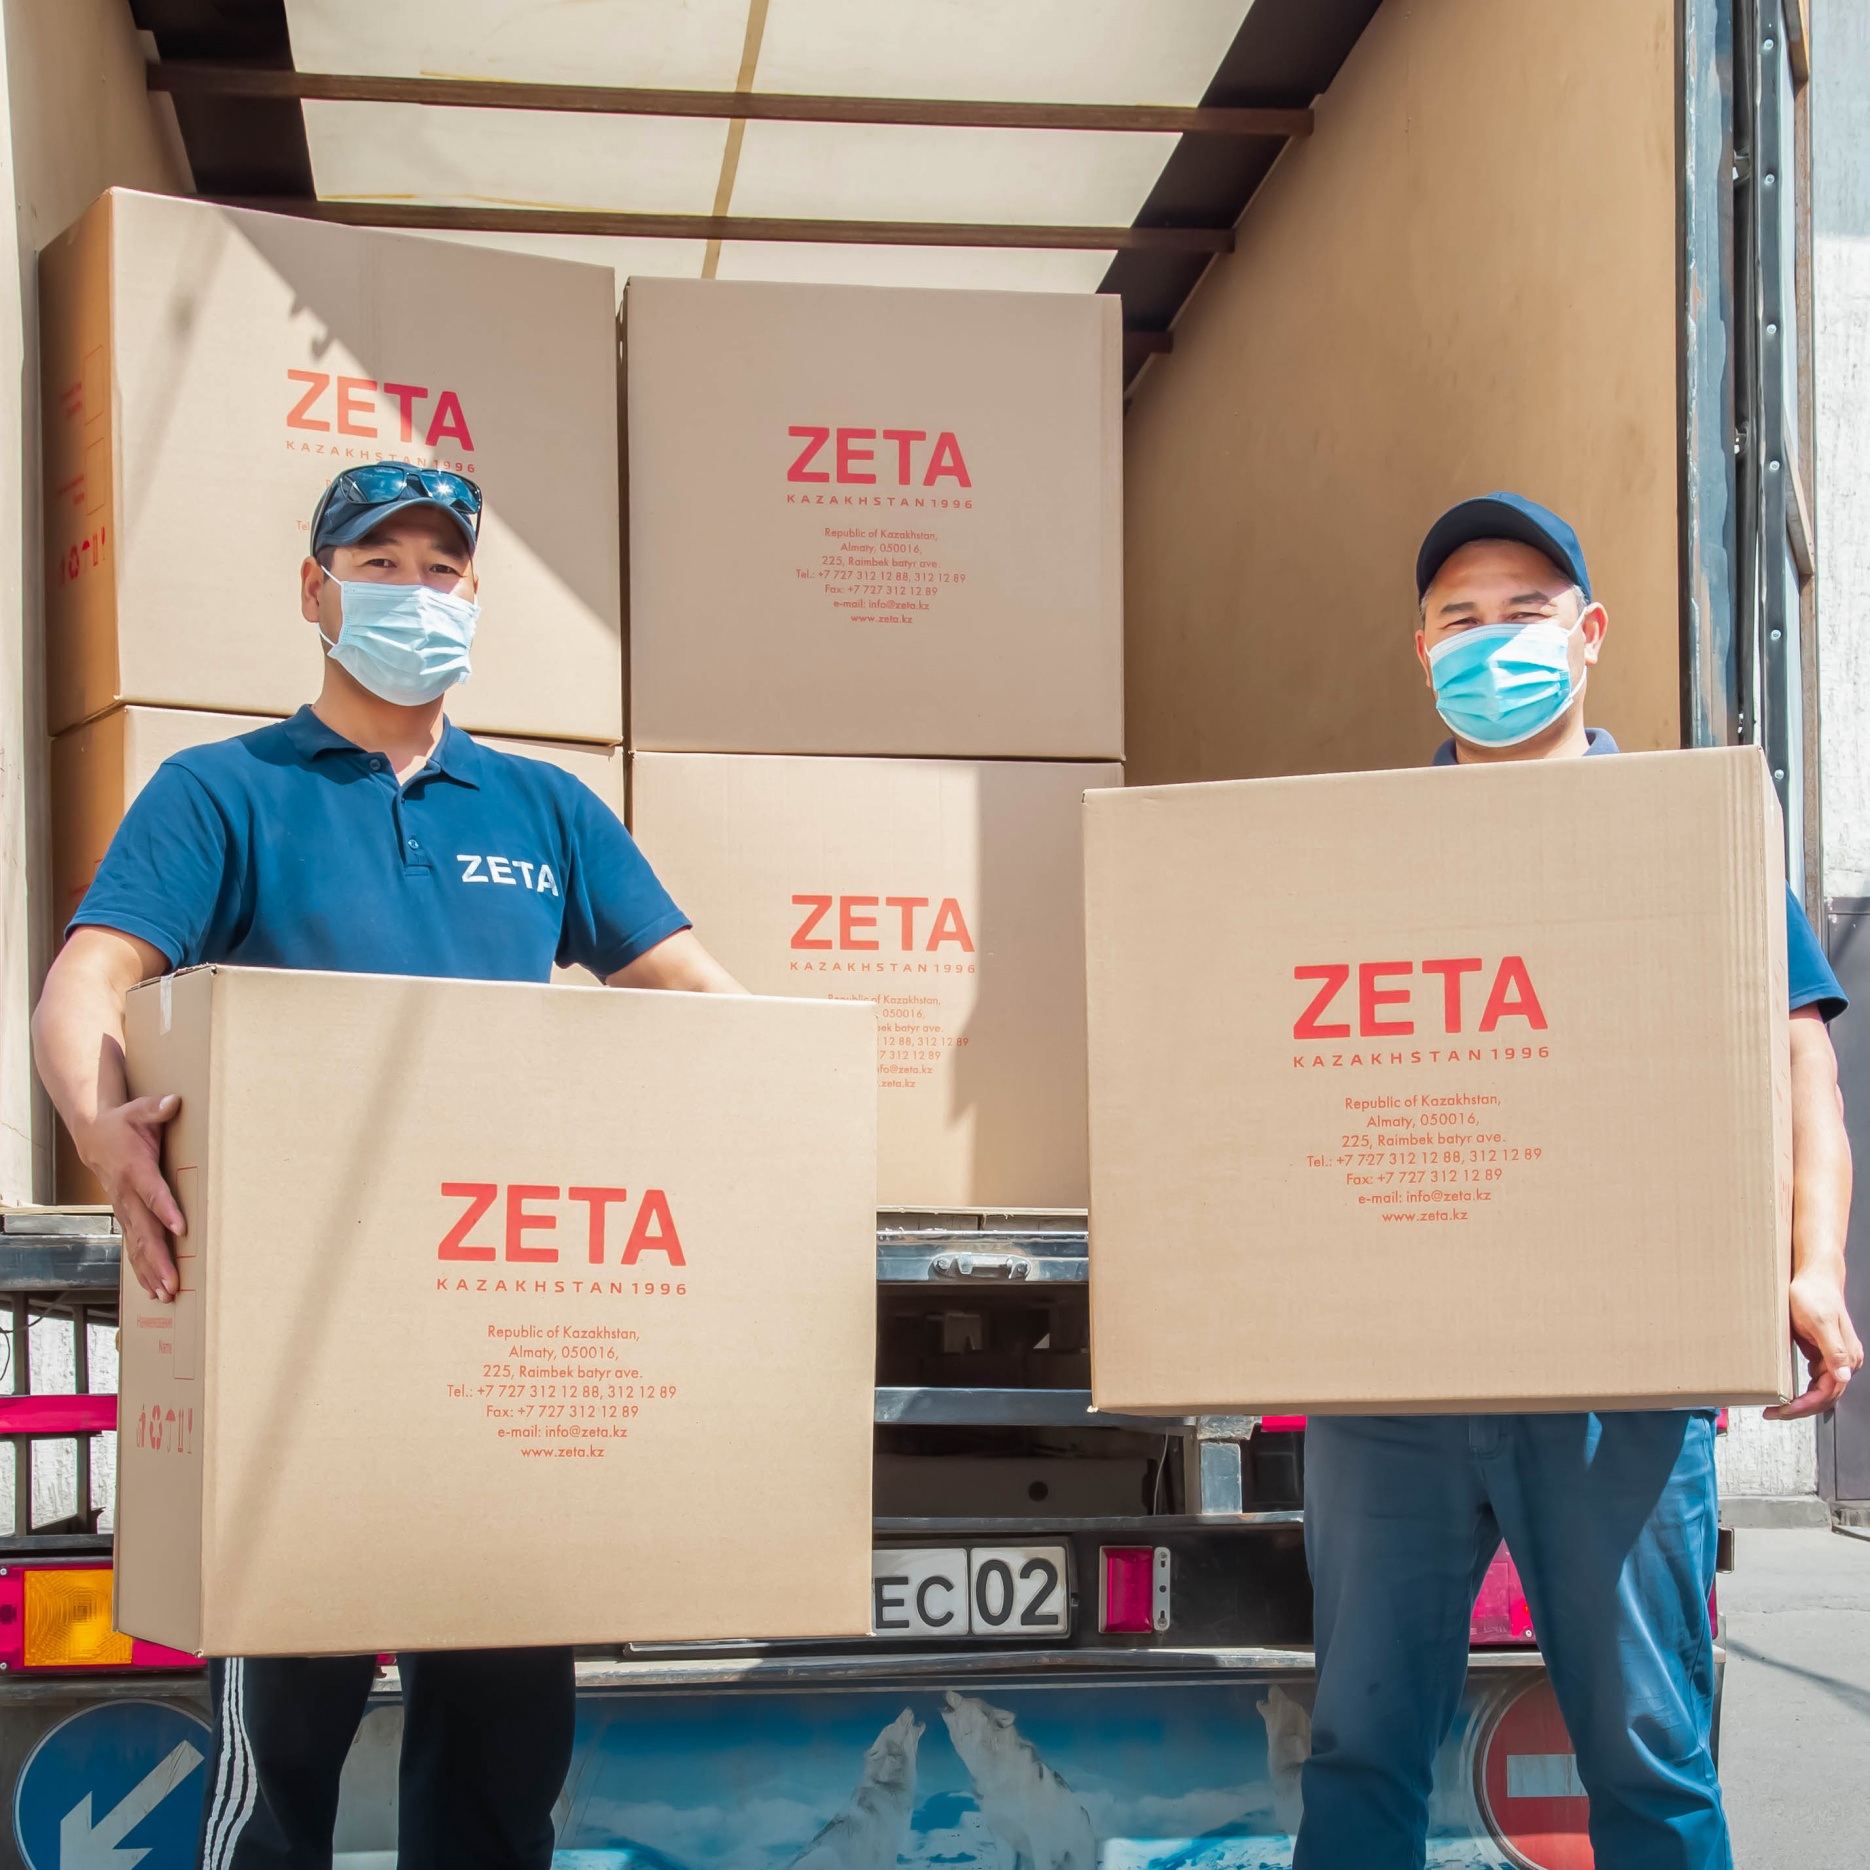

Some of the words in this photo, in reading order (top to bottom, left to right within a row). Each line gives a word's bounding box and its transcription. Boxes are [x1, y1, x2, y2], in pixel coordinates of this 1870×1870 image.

[286, 368, 475, 452] ZETA
[786, 425, 972, 488] ZETA
[825, 527, 865, 539] Republic
[868, 529, 878, 538] of
[880, 529, 938, 541] Kazakhstan,
[840, 542, 876, 554] Almaty,
[880, 543, 922, 555] 050016,
[822, 556, 845, 567] 225,
[848, 557, 889, 567] Raimbek
[892, 557, 917, 570] batyr
[919, 560, 941, 569] ave.
[796, 569, 815, 579] Tel.:
[818, 570, 831, 580] +7
[833, 570, 853, 580] 727
[857, 570, 876, 580] 312
[881, 571, 892, 581] 12
[895, 571, 911, 583] 88,
[914, 572, 934, 582] 312
[938, 573, 950, 583] 12
[953, 573, 966, 583] 89
[825, 584, 845, 594] Fax:
[847, 585, 860, 595] +7
[863, 585, 883, 595] 727
[886, 585, 906, 595] 312
[910, 586, 922, 596] 12
[925, 586, 938, 596] 89
[833, 599, 866, 609] e-mail:
[869, 599, 930, 610] info@zeta.kz
[851, 613, 913, 624] www.zeta.kz
[456, 854, 559, 897] ZETA
[790, 893, 976, 952] ZETA
[883, 994, 941, 1006] Kazakhstan,
[1293, 955, 1548, 1040] ZETA
[882, 1008, 925, 1020] 050016,
[894, 1023, 920, 1034] batyr
[883, 1037, 895, 1046] 12
[898, 1037, 914, 1048] 88,
[917, 1037, 937, 1047] 312
[941, 1038, 953, 1047] 12
[956, 1038, 969, 1047] 89
[889, 1051, 909, 1060] 312
[913, 1051, 925, 1060] 12
[928, 1051, 941, 1060] 89
[1345, 1096, 1401, 1113] Republic
[1404, 1095, 1418, 1108] of
[1421, 1093, 1501, 1107] Kazakhstan,
[1366, 1115, 1416, 1130] Almaty,
[1420, 1112, 1480, 1126] 050016,
[1341, 1134, 1373, 1150] 225,
[1377, 1132, 1434, 1147] Raimbek
[1437, 1132, 1472, 1147] batyr
[1476, 1132, 1506, 1144] ave.
[1307, 1155, 1333, 1168] Tel.:
[1336, 1154, 1354, 1167] +7
[1357, 1153, 1385, 1166] 727
[1389, 1152, 1416, 1165] 312
[1422, 1151, 1438, 1164] 12
[1443, 1151, 1465, 1165] 88,
[1469, 1149, 1497, 1163] 312
[1503, 1149, 1519, 1162] 12
[1524, 1148, 1542, 1161] 89
[1346, 1172, 1374, 1186] Fax:
[1377, 1171, 1394, 1184] +7
[1399, 1170, 1426, 1184] 727
[1430, 1170, 1457, 1183] 312
[1463, 1169, 1480, 1182] 12
[1484, 1168, 1503, 1181] 89
[1358, 1191, 1402, 1205] e-mail:
[1406, 1188, 1491, 1203] info@zeta.kz
[1382, 1208, 1468, 1222] www.zeta.kz
[438, 1181, 687, 1267] ZETA
[488, 1325, 543, 1340] Republic
[546, 1326, 559, 1339] of
[563, 1326, 640, 1341] Kazakhstan,
[509, 1345, 557, 1361] Almaty,
[561, 1346, 619, 1361] 050016,
[482, 1364, 515, 1380] 225,
[519, 1365, 574, 1378] Raimbek
[577, 1366, 611, 1382] batyr
[614, 1369, 643, 1378] ave.
[447, 1384, 473, 1398] Tel.:
[477, 1385, 494, 1398] +7
[498, 1385, 526, 1398] 727
[529, 1385, 556, 1398] 312
[561, 1385, 578, 1398] 12
[582, 1385, 603, 1400] 88,
[607, 1385, 634, 1399] 312
[639, 1386, 655, 1399] 12
[659, 1386, 677, 1399] 89
[486, 1405, 514, 1418] Fax:
[517, 1405, 534, 1418] +7
[538, 1405, 565, 1418] 727
[569, 1405, 595, 1418] 312
[601, 1405, 617, 1418] 12
[621, 1406, 639, 1418] 89
[497, 1424, 541, 1438] e-mail:
[545, 1424, 628, 1438] info@zeta.kz
[521, 1444, 605, 1458] www.zeta.kz
[975, 1558, 1059, 1627] 02
